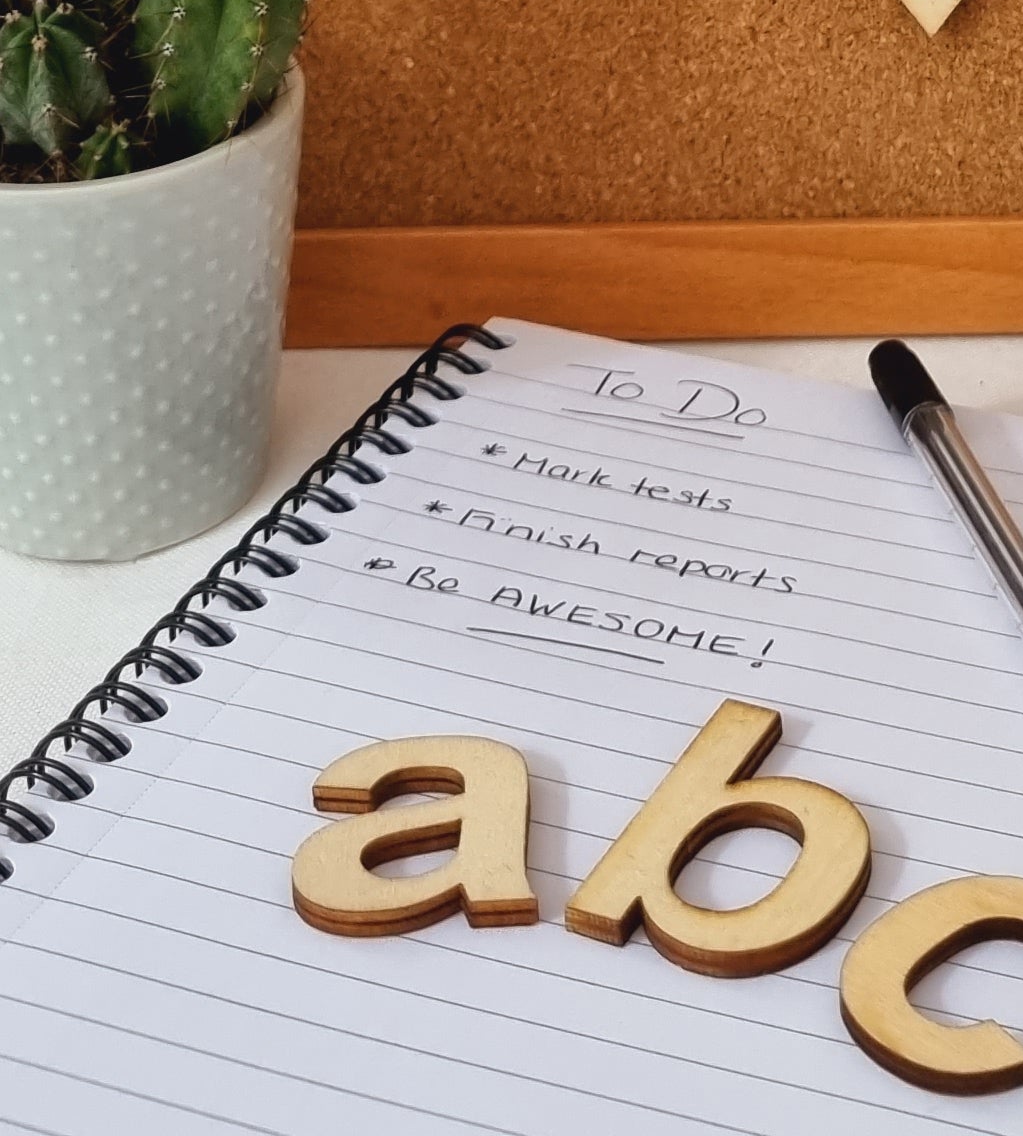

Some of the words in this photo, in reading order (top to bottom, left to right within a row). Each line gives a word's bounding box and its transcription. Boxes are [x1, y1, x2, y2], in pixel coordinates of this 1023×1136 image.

[567, 363, 645, 400] To
[660, 378, 767, 426] Do
[512, 452, 613, 488] Mark
[630, 476, 733, 513] tests
[405, 565, 460, 594] Be
[458, 508, 601, 555] Finish
[628, 547, 798, 595] reports
